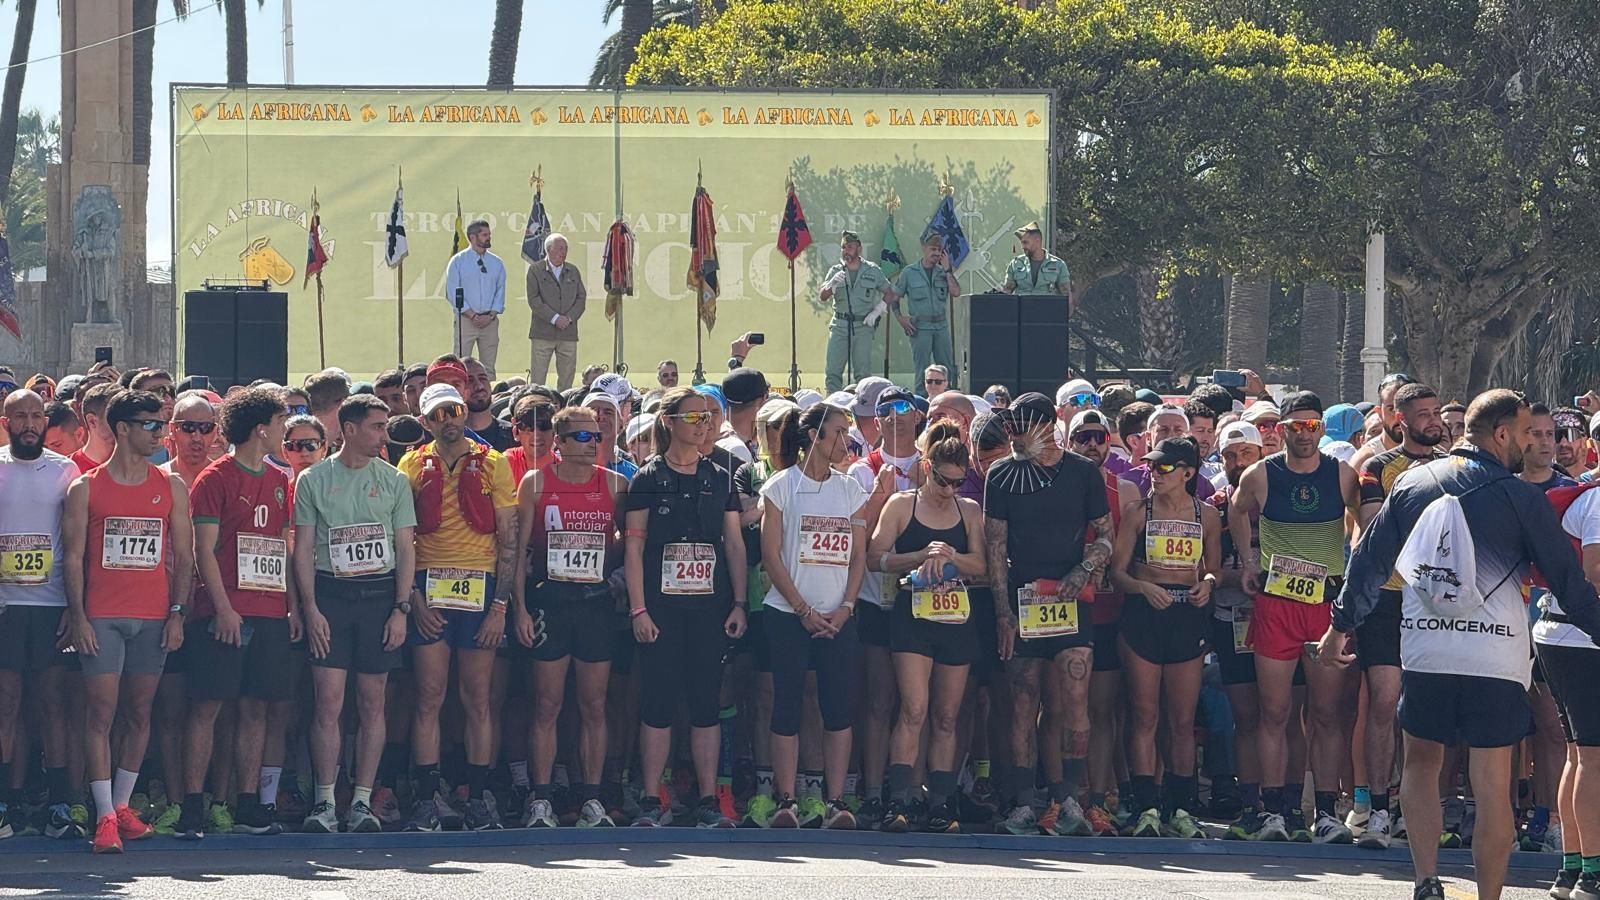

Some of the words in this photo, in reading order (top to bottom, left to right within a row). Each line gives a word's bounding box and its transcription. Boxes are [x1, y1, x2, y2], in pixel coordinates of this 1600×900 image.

[217, 103, 244, 120] LA
[249, 104, 351, 121] AFRICANA
[388, 105, 415, 122] LA
[420, 106, 521, 123] AFRICANA
[559, 106, 586, 123] LA
[590, 106, 690, 124] AFRICANA
[722, 107, 750, 125] LA
[754, 107, 853, 126] AFRICANA
[889, 108, 915, 126] LA
[920, 108, 1018, 127] AFRICANA
[188, 222, 222, 259] LA
[253, 504, 269, 528] 10
[120, 537, 157, 556] 1774
[345, 541, 385, 562] 1670
[812, 533, 849, 552] 2426
[1165, 538, 1193, 557] 843
[14, 552, 44, 571] 325
[252, 555, 282, 576] 1660
[563, 550, 599, 569] 1471
[676, 561, 712, 579] 2498
[451, 579, 471, 596] 48
[1286, 577, 1315, 597] 488
[932, 592, 960, 611] 869
[1039, 603, 1068, 623] 314
[1416, 617, 1515, 638] COMGEMEL
